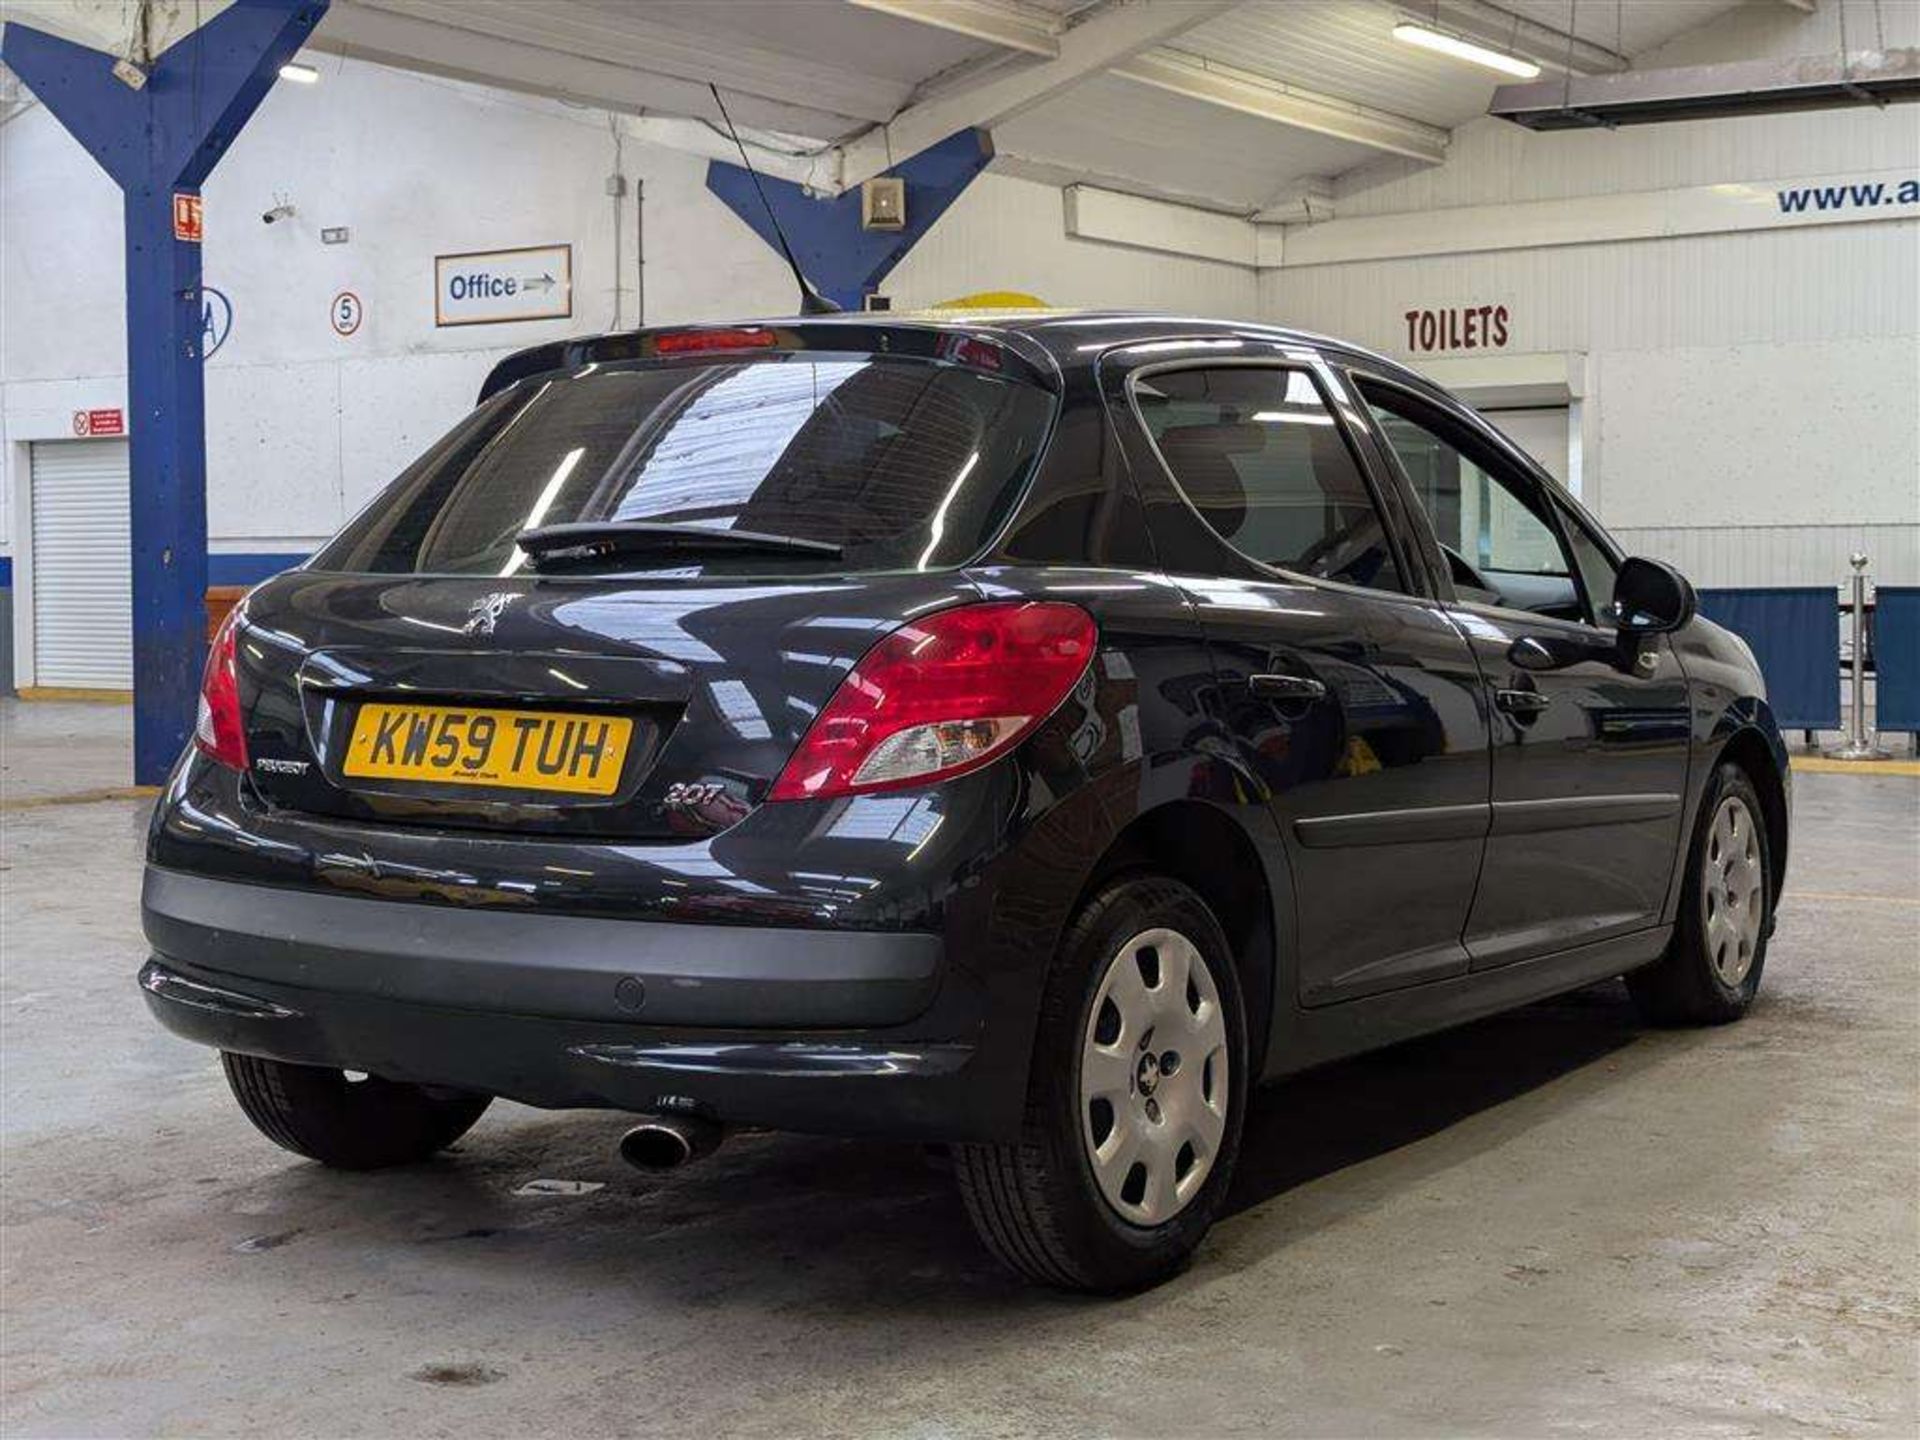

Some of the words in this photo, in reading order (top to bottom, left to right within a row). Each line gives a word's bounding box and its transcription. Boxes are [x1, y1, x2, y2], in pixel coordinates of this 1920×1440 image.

[1778, 180, 1920, 212] www.a
[450, 274, 516, 300] Office
[340, 298, 351, 320] 5
[1405, 305, 1508, 351] TOILETS
[369, 711, 496, 770] KW59
[511, 717, 610, 778] TUH
